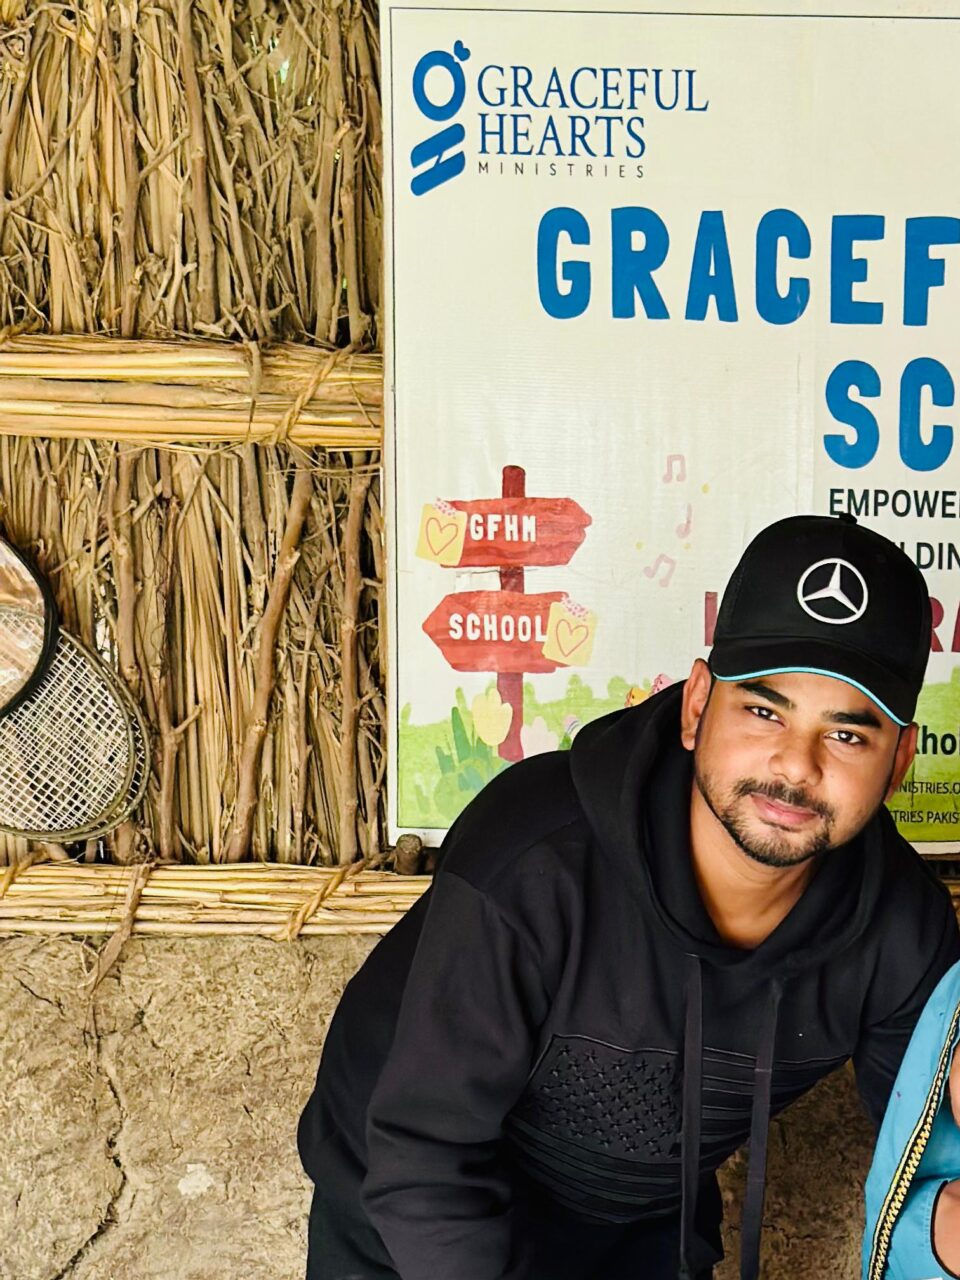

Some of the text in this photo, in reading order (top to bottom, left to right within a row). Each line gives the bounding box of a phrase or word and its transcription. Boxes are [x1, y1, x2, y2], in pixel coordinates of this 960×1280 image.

[477, 64, 709, 112] GRACEFUL
[478, 113, 647, 160] HEARTS
[478, 161, 646, 179] MINISTRIES
[469, 514, 537, 543] GFHM
[448, 612, 548, 643] SCHOOL
[890, 810, 924, 823] TRIES
